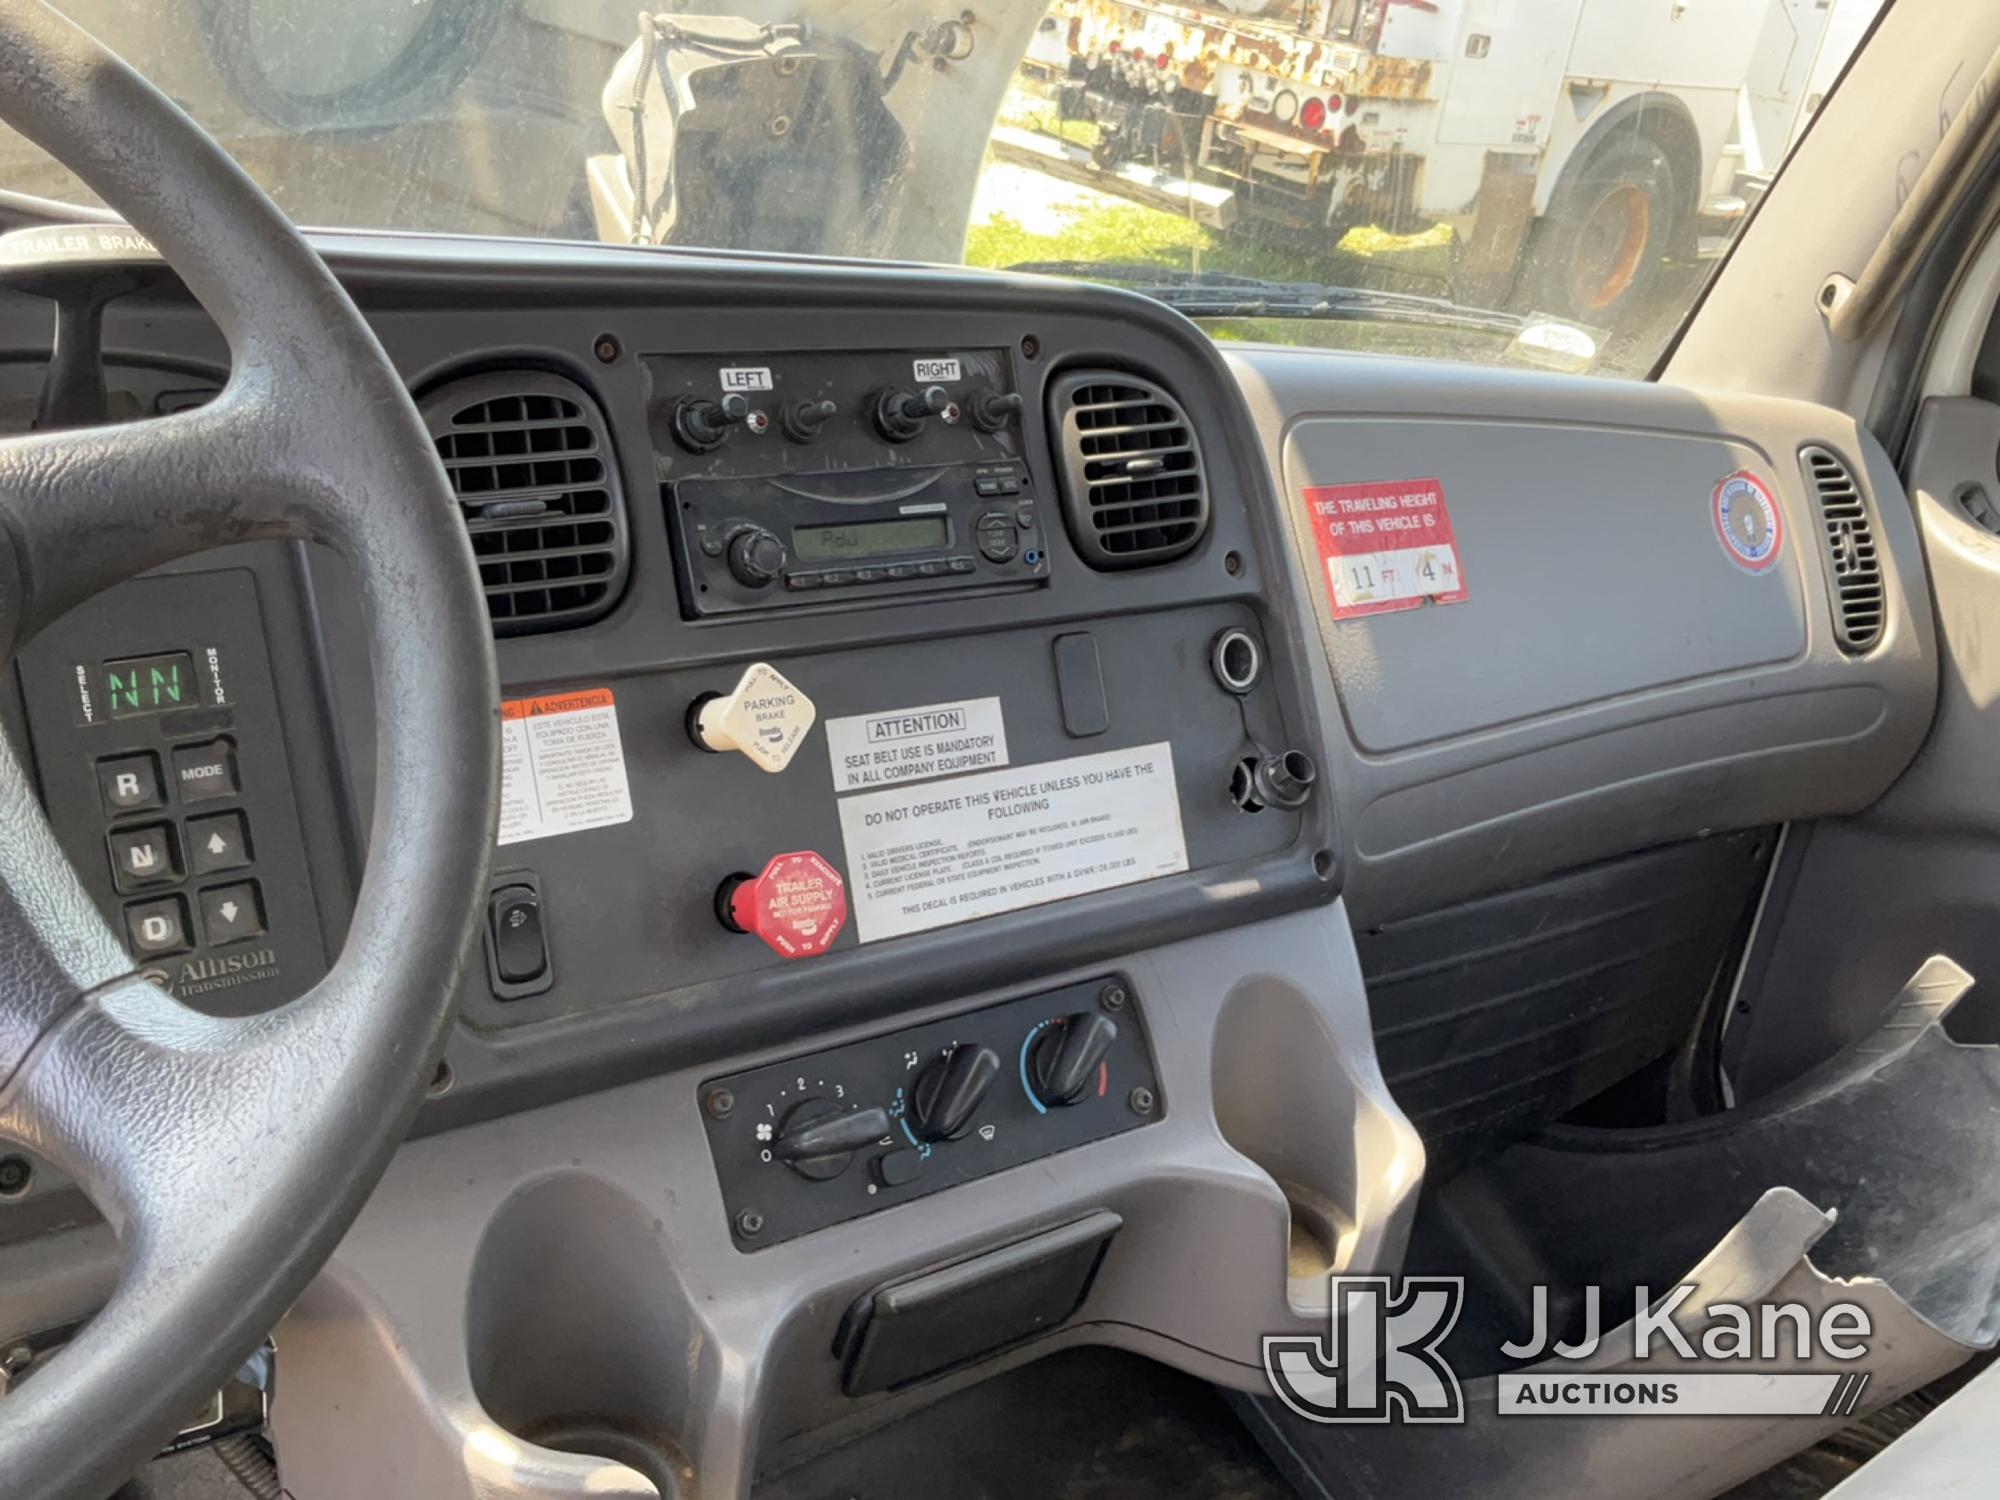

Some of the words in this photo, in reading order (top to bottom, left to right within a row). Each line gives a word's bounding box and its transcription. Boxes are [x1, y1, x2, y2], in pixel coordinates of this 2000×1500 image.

[8, 236, 91, 255] TRAILER
[725, 371, 764, 387] LEFT
[916, 362, 957, 378] RIGHT
[1314, 502, 1337, 516] THE
[1339, 496, 1398, 514] TRAVELING
[1399, 492, 1438, 508] HEIGHT
[1329, 522, 1346, 536] OF
[1348, 520, 1375, 535] THIS
[1376, 515, 1421, 532] VEHICLE
[1423, 513, 1436, 527] IS
[1351, 565, 1376, 590] 11
[1422, 560, 1437, 581] 4
[206, 647, 226, 705] MONITOR
[76, 664, 93, 723] SELECT
[544, 694, 608, 712] ADVERTENCIA
[743, 694, 796, 712] PARKING
[755, 710, 785, 722] BRAKE
[875, 711, 961, 739] ATTENTION
[844, 753, 870, 769] SEAT
[874, 749, 899, 765] BELT
[901, 745, 922, 761] USE
[924, 743, 934, 757] IS
[936, 734, 994, 754] MANDATORY
[181, 764, 224, 781] MODE
[848, 772, 859, 785] IN
[862, 768, 882, 783] ALL
[884, 760, 935, 781] COMPANY
[938, 751, 997, 770] EQUIPMENT
[116, 773, 140, 797] R
[865, 812, 883, 826] DO
[885, 807, 909, 822] NOT
[912, 798, 962, 818] OPERATE
[964, 792, 990, 808] THIS
[993, 784, 1037, 802] VEHICLE
[1039, 776, 1080, 794] UNLESS
[1082, 772, 1104, 785] YOU
[1105, 767, 1132, 781] HAVE
[1134, 762, 1154, 776] THE
[987, 798, 1050, 820] FOLLOWING
[130, 844, 154, 868] N
[867, 849, 886, 860] VALID
[887, 844, 914, 857] DRIVERS
[870, 859, 888, 869] VALID
[889, 854, 917, 867] MEDICAL
[891, 863, 917, 875] VEHICLE
[918, 855, 956, 870] INSPECTION
[776, 878, 823, 894] TRAILER
[873, 876, 903, 889] CURRENT
[904, 871, 931, 883] LICENSE
[875, 886, 905, 898] CURRENT
[907, 880, 935, 892] FEDERAL
[947, 873, 966, 884] STATE
[967, 865, 1002, 879] EQUIPMENT
[768, 896, 789, 910] AIR
[791, 889, 833, 905] SUPPLY
[902, 903, 921, 916] THIS
[922, 898, 948, 911] DECAL
[949, 896, 957, 905] IS
[959, 887, 998, 902] REQUIRED
[1000, 885, 1008, 893] IN
[1009, 876, 1045, 892] VEHICLES
[1046, 872, 1066, 884] WITH
[1066, 871, 1073, 879] A
[144, 916, 168, 941] D
[179, 949, 276, 984] Allison
[797, 1077, 806, 1090] 2
[835, 1084, 845, 1098] 3
[766, 1104, 775, 1117] 1
[761, 1149, 772, 1162] 0
